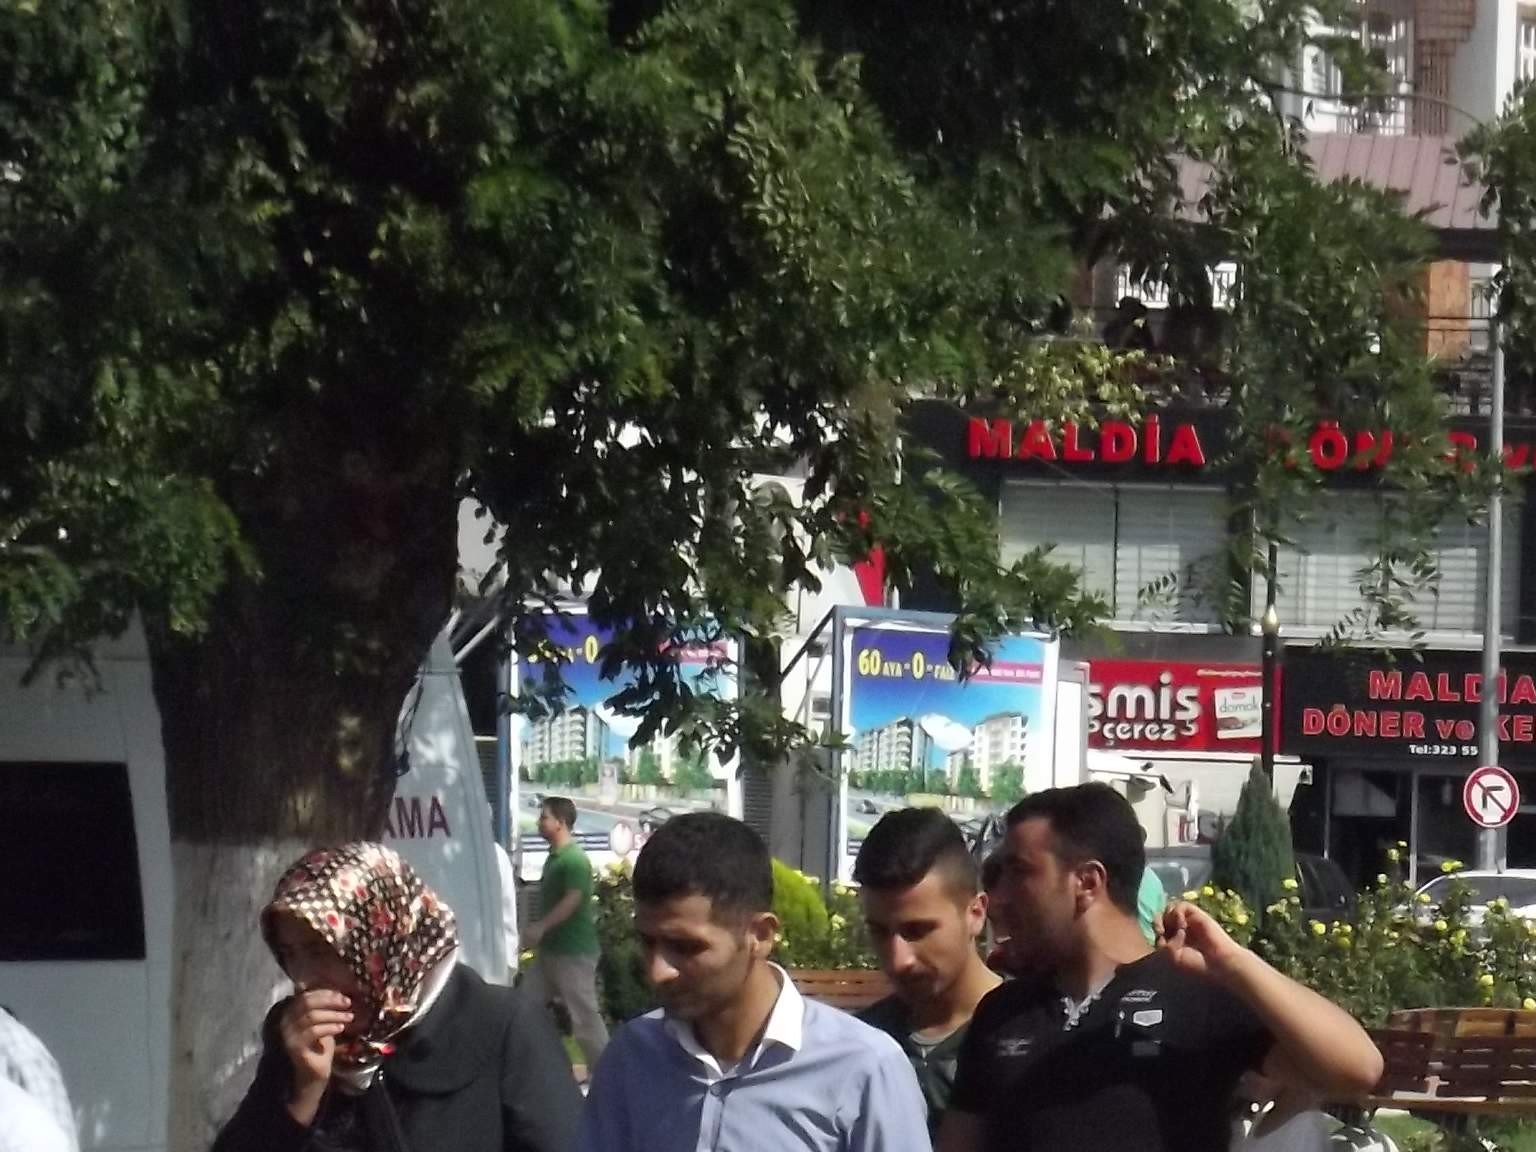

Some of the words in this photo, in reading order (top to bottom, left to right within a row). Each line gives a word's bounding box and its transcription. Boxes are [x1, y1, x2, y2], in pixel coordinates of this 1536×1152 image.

[858, 649, 881, 676] 60
[882, 662, 903, 678] AYA
[1102, 722, 1177, 746] çerez
[1302, 704, 1426, 739] DÖNER
[1435, 719, 1476, 741] ve
[1408, 744, 1457, 756] Tel:323
